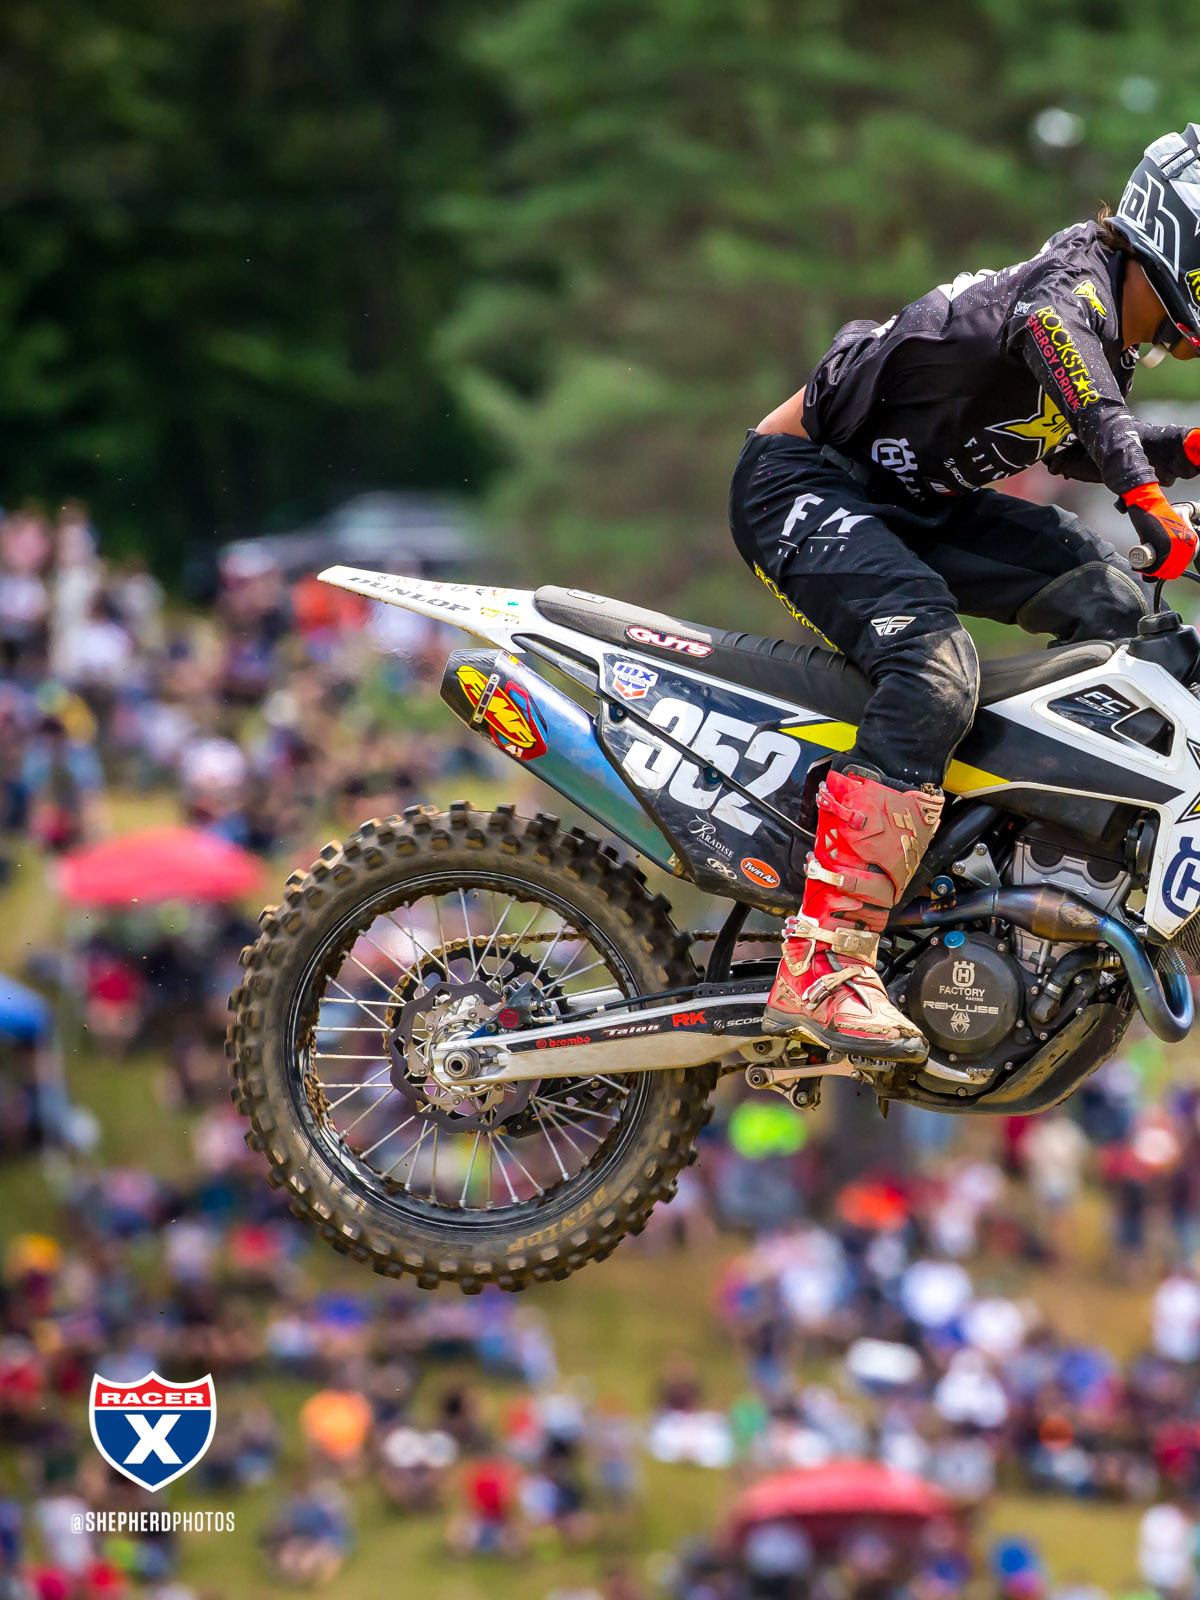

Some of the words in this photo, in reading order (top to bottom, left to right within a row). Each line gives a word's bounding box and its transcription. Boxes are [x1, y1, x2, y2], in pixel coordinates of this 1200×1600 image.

[1027, 315, 1059, 364] ENERGY
[1054, 367, 1080, 410] DRINK
[348, 577, 471, 611] DUNLOP
[627, 627, 712, 656] GUTS
[456, 670, 537, 743] FMF
[622, 697, 801, 836] 352
[687, 815, 734, 858] PARADISE
[744, 861, 764, 877] Twin
[763, 874, 777, 885] Air
[939, 985, 985, 997] FACTORY
[672, 1011, 707, 1028] RK
[923, 1000, 999, 1015] REKLUSE
[549, 1035, 591, 1048] brembo
[604, 1024, 660, 1037] Talon
